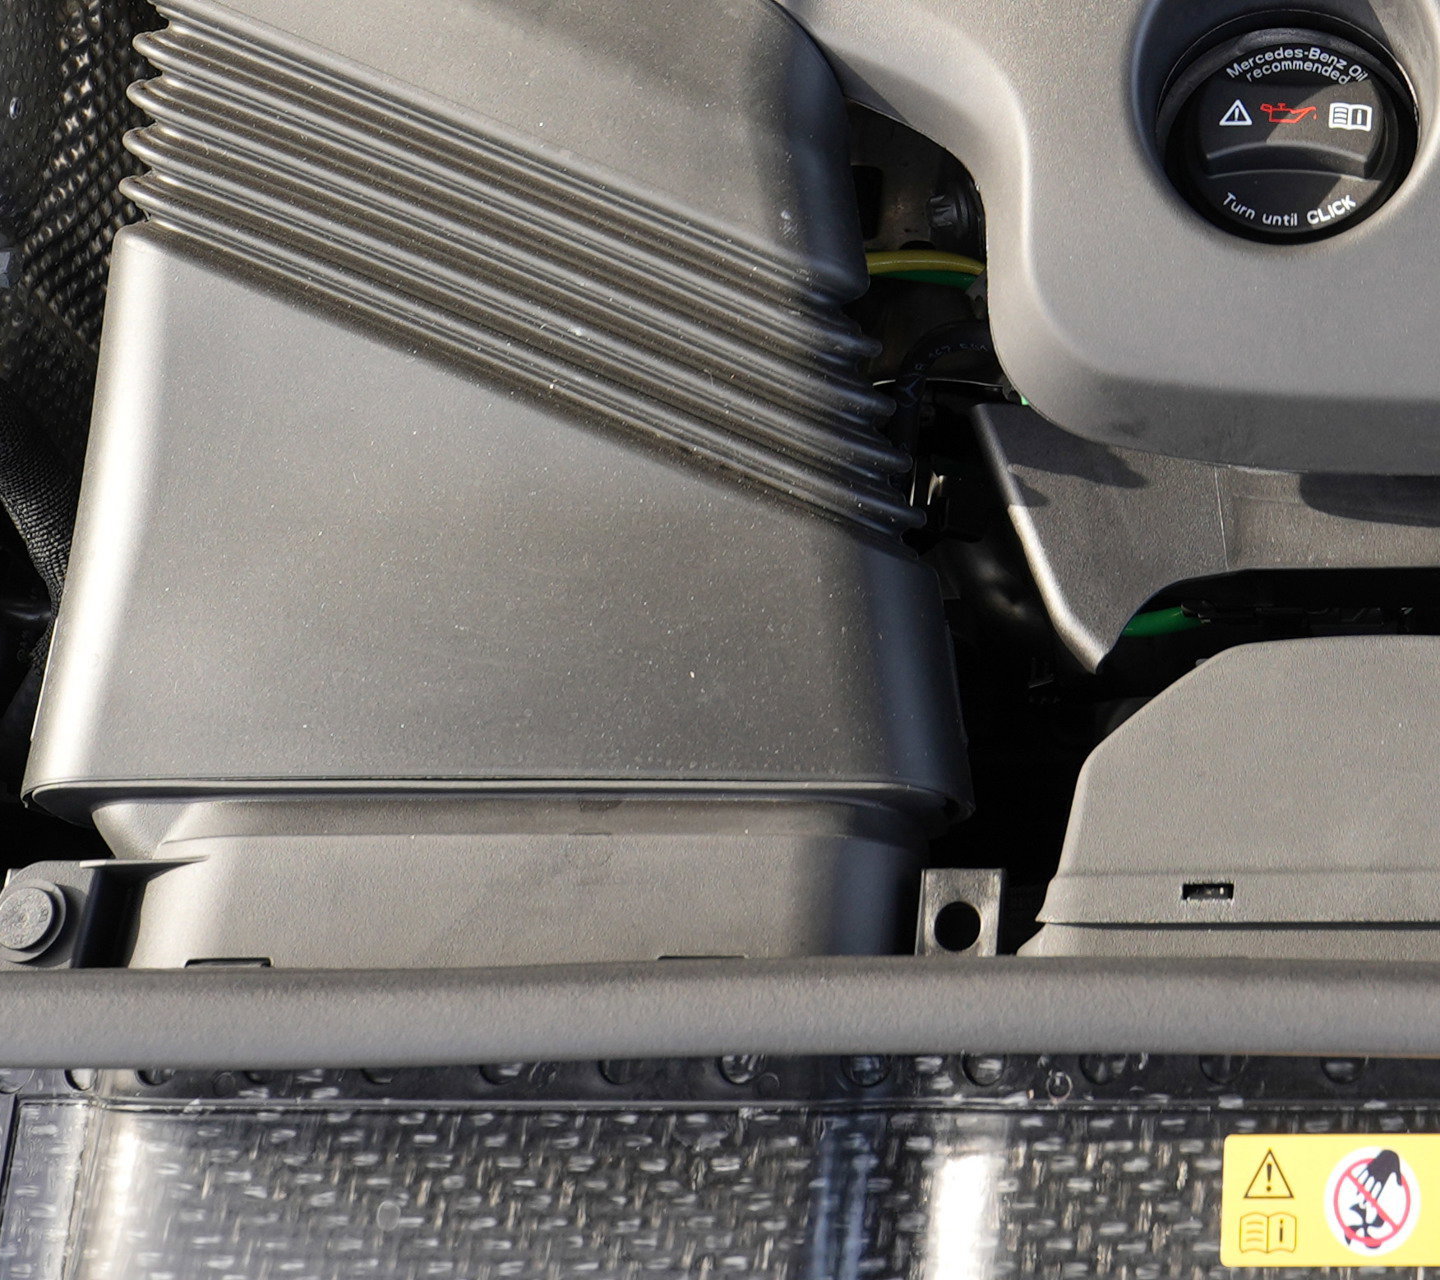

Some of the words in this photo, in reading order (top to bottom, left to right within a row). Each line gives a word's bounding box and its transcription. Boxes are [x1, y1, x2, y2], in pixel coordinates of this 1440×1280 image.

[1226, 46, 1347, 79] Mercedes-Benz
[1348, 62, 1369, 83] Oil
[1245, 60, 1351, 84] recommended
[1222, 192, 1256, 219] Turn
[1262, 213, 1298, 227] until
[1306, 194, 1357, 225] CLICK
